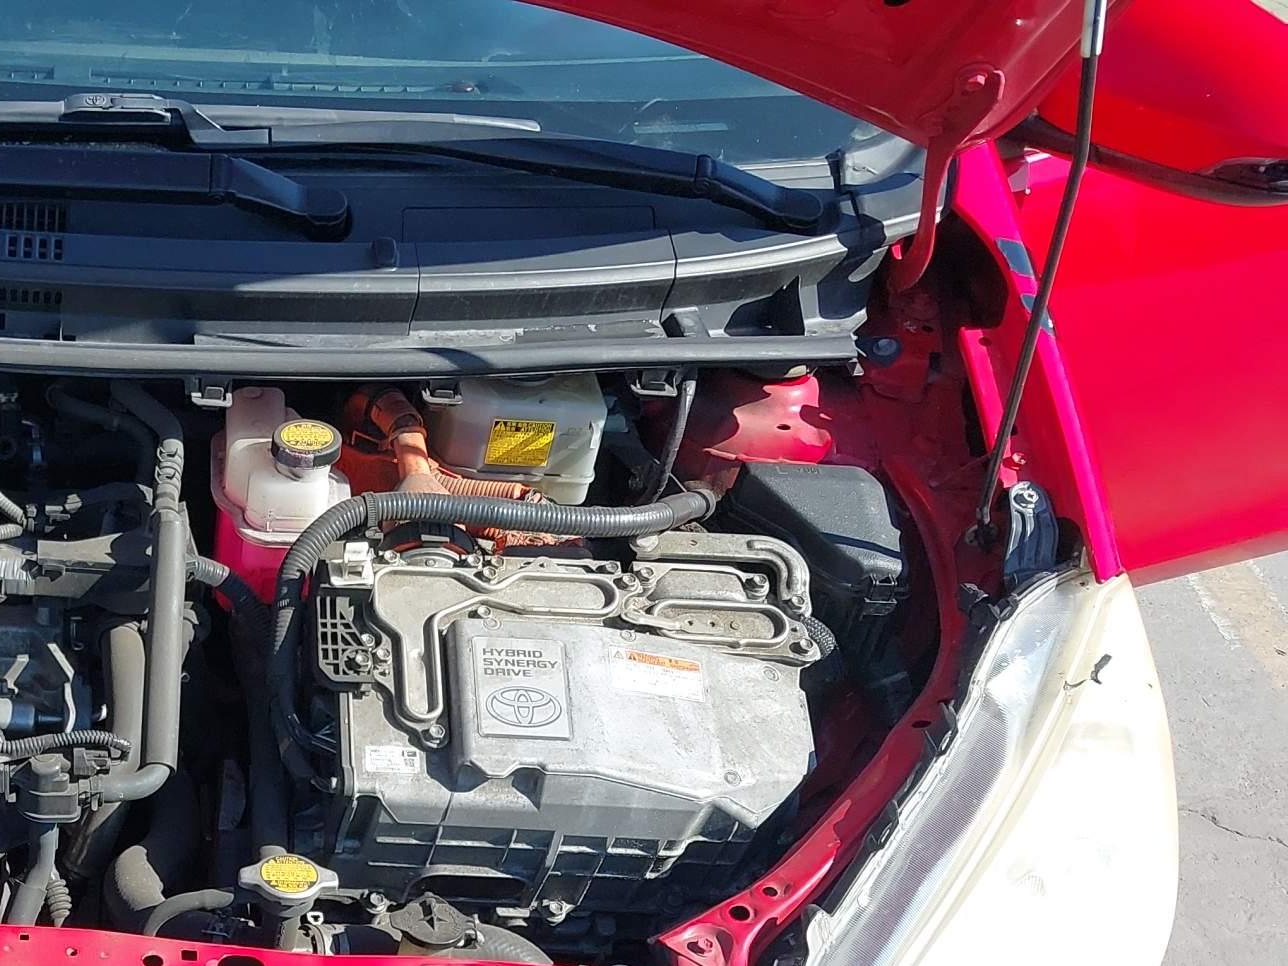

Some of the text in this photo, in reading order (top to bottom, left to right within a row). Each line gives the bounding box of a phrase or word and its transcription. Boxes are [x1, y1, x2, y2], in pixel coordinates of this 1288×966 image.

[482, 648, 543, 658] HYBRID
[483, 657, 558, 669] SYNERGY
[483, 667, 532, 677] DRIVE
